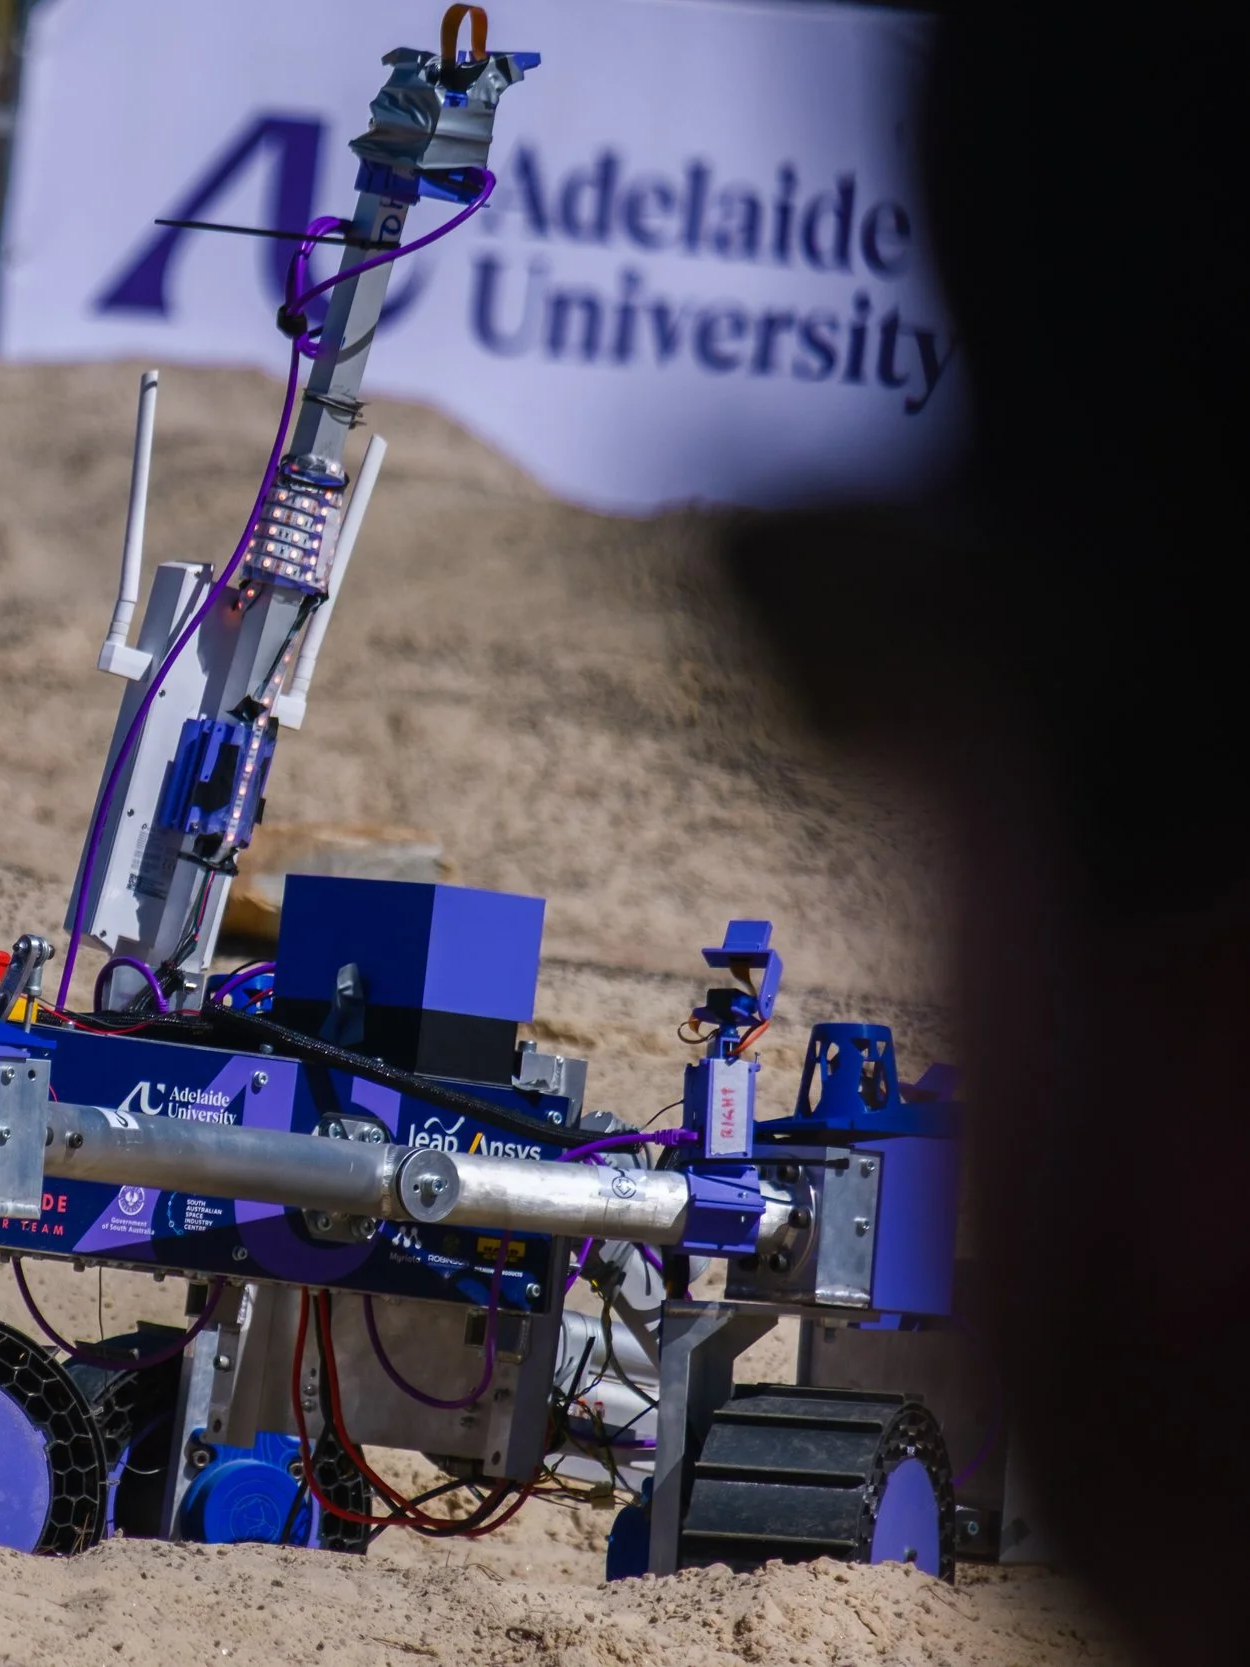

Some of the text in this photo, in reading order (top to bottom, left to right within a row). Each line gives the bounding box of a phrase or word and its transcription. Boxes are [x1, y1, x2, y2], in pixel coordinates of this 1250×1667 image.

[477, 145, 913, 282] Adelaide
[468, 252, 956, 416] University
[169, 1086, 230, 1107] Adelaide
[167, 1102, 237, 1125] University
[408, 1123, 542, 1161] leap Ansys
[186, 1198, 207, 1207] SOUTH
[186, 1205, 223, 1215] AUSTRALIAN
[110, 1216, 147, 1227] Government
[184, 1218, 214, 1227] INDUSTRY
[185, 1211, 204, 1220] SPACE
[21, 1219, 64, 1236] TEAM
[109, 1223, 127, 1232] South
[128, 1226, 155, 1236] Australia
